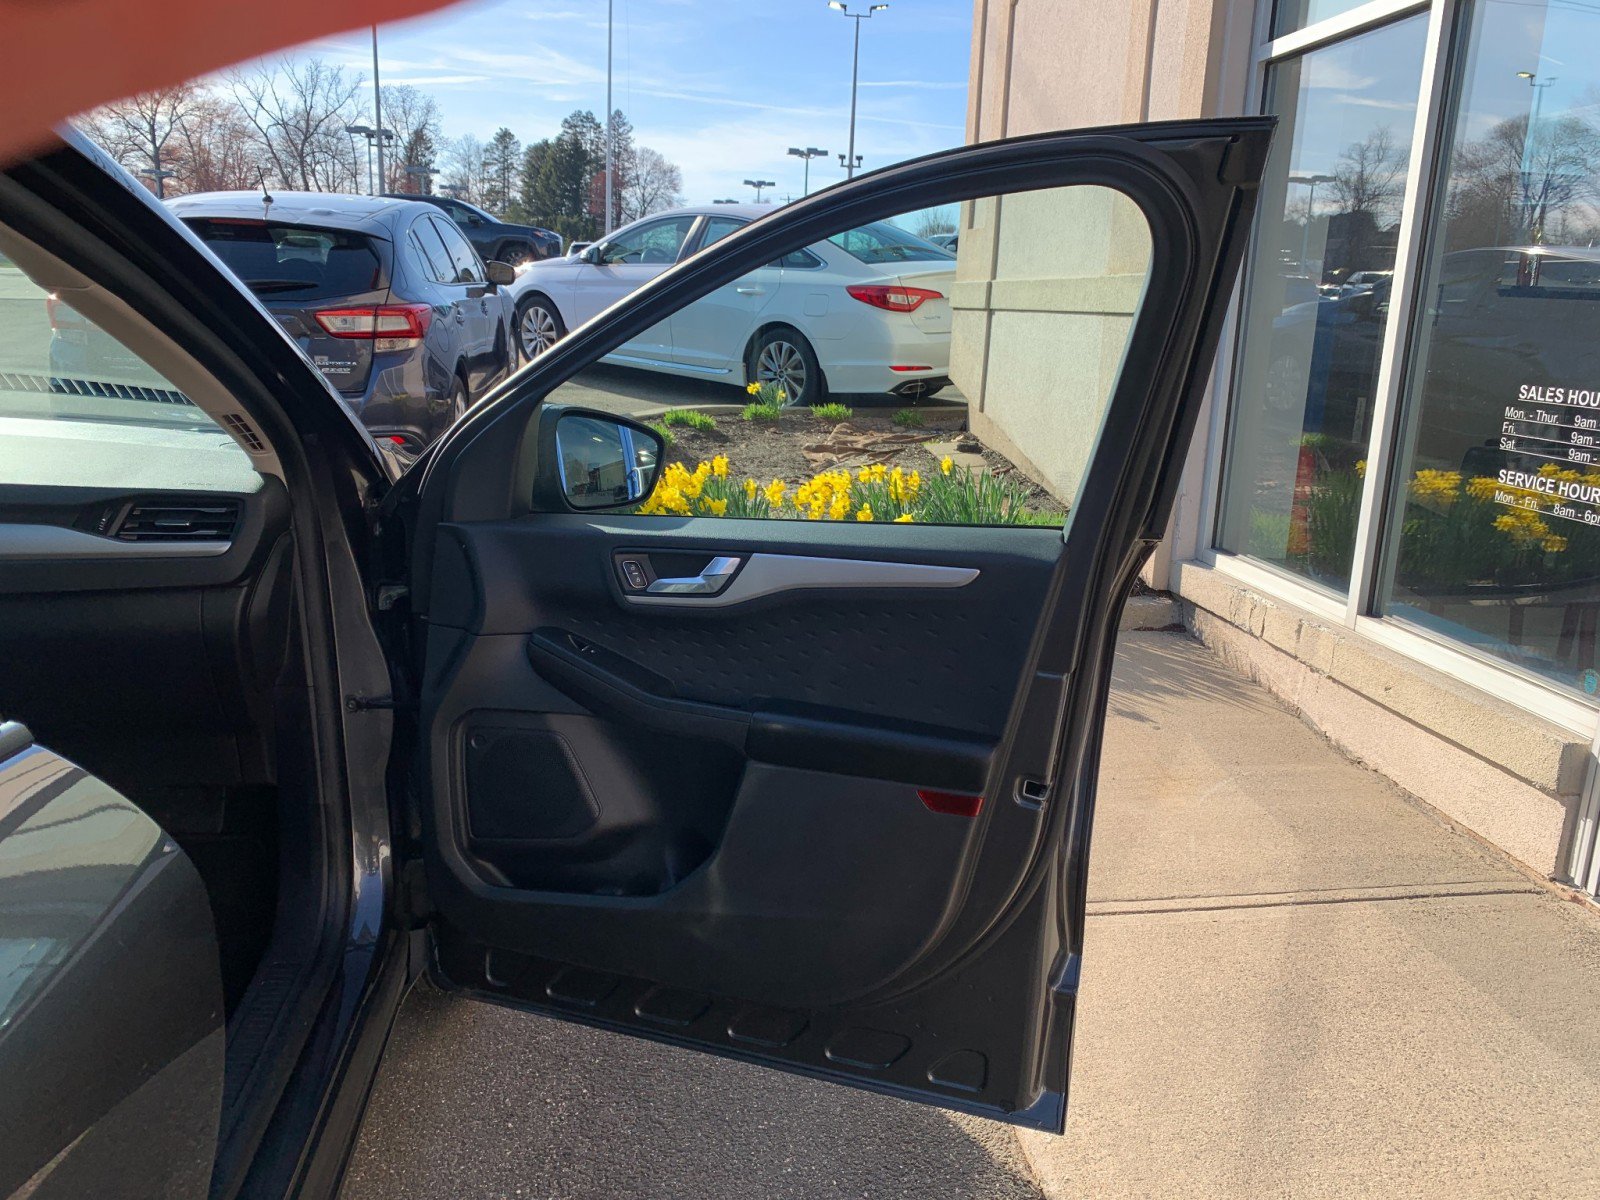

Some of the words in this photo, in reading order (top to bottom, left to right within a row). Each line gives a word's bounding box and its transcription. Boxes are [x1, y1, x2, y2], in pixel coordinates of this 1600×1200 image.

[1519, 385, 1565, 402] SALES
[1505, 407, 1526, 420] Mon.
[1536, 410, 1559, 424] Thur.
[1574, 415, 1597, 428] 9am
[1502, 422, 1516, 434] Fri.
[1571, 432, 1593, 446] 9am
[1500, 437, 1516, 450] Sat.
[1568, 448, 1590, 463] 9am
[1498, 469, 1555, 494] SERVICE
[1495, 490, 1516, 505] Mon.
[1525, 497, 1539, 510] Fri.
[1553, 503, 1575, 518] 8am
